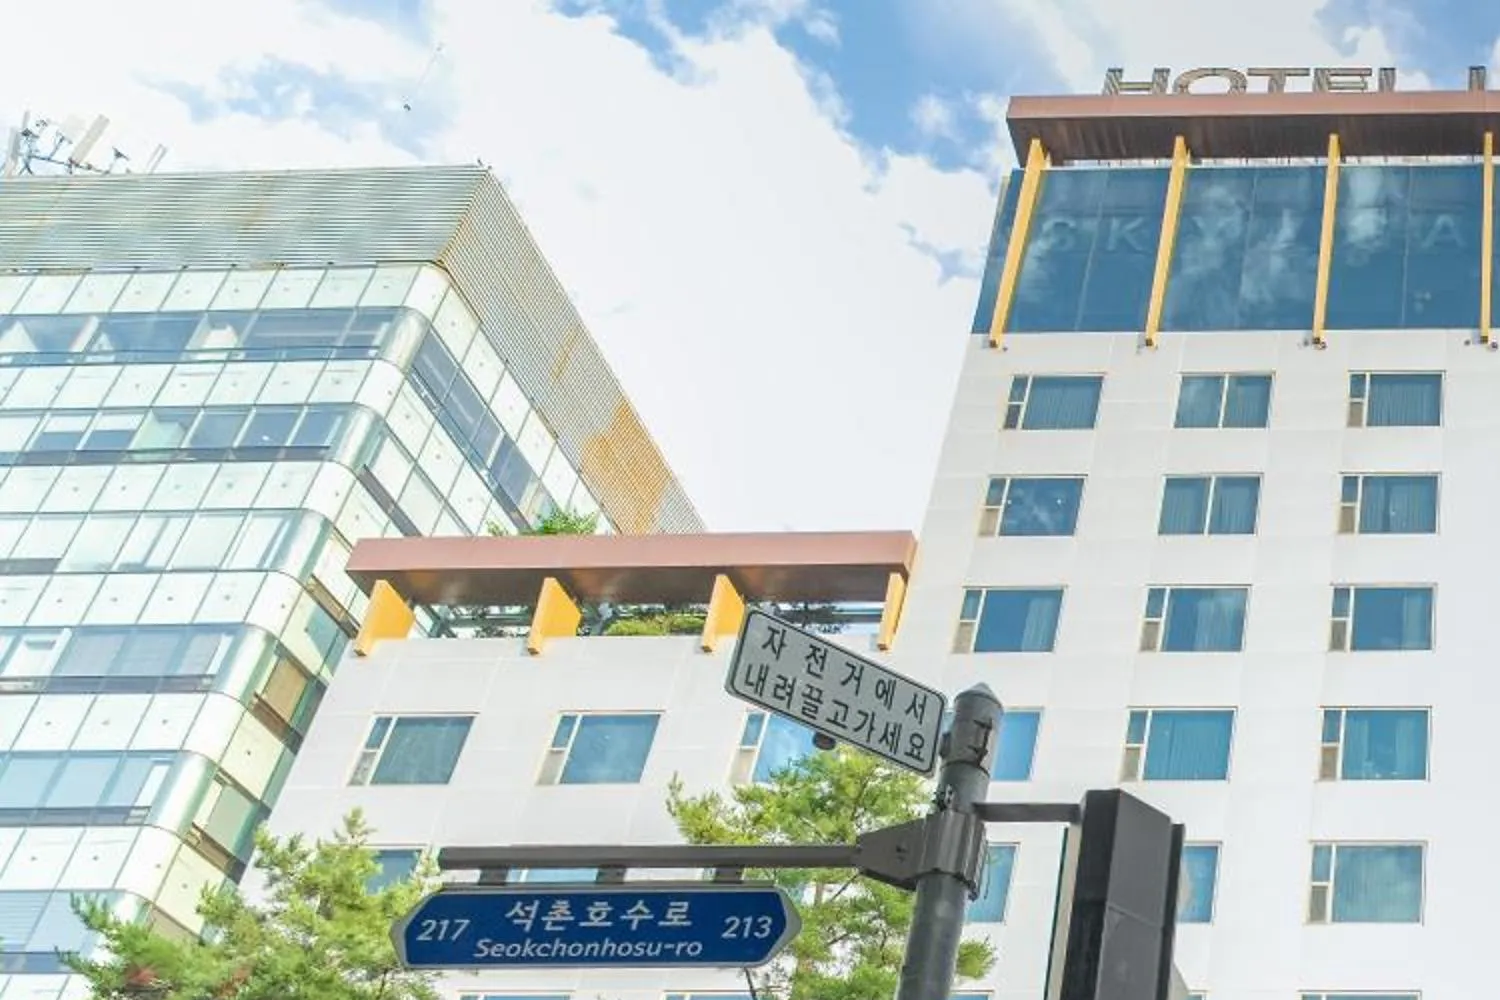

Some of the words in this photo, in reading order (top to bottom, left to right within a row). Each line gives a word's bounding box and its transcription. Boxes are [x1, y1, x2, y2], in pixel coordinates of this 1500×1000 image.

[761, 625, 928, 725] 자전거에서
[744, 662, 926, 763] 내려끌고가세요
[416, 919, 470, 941] 217
[504, 899, 692, 933] 석촌호수로
[721, 916, 774, 939] 213
[473, 938, 703, 959] Seokchonhosu-ro
